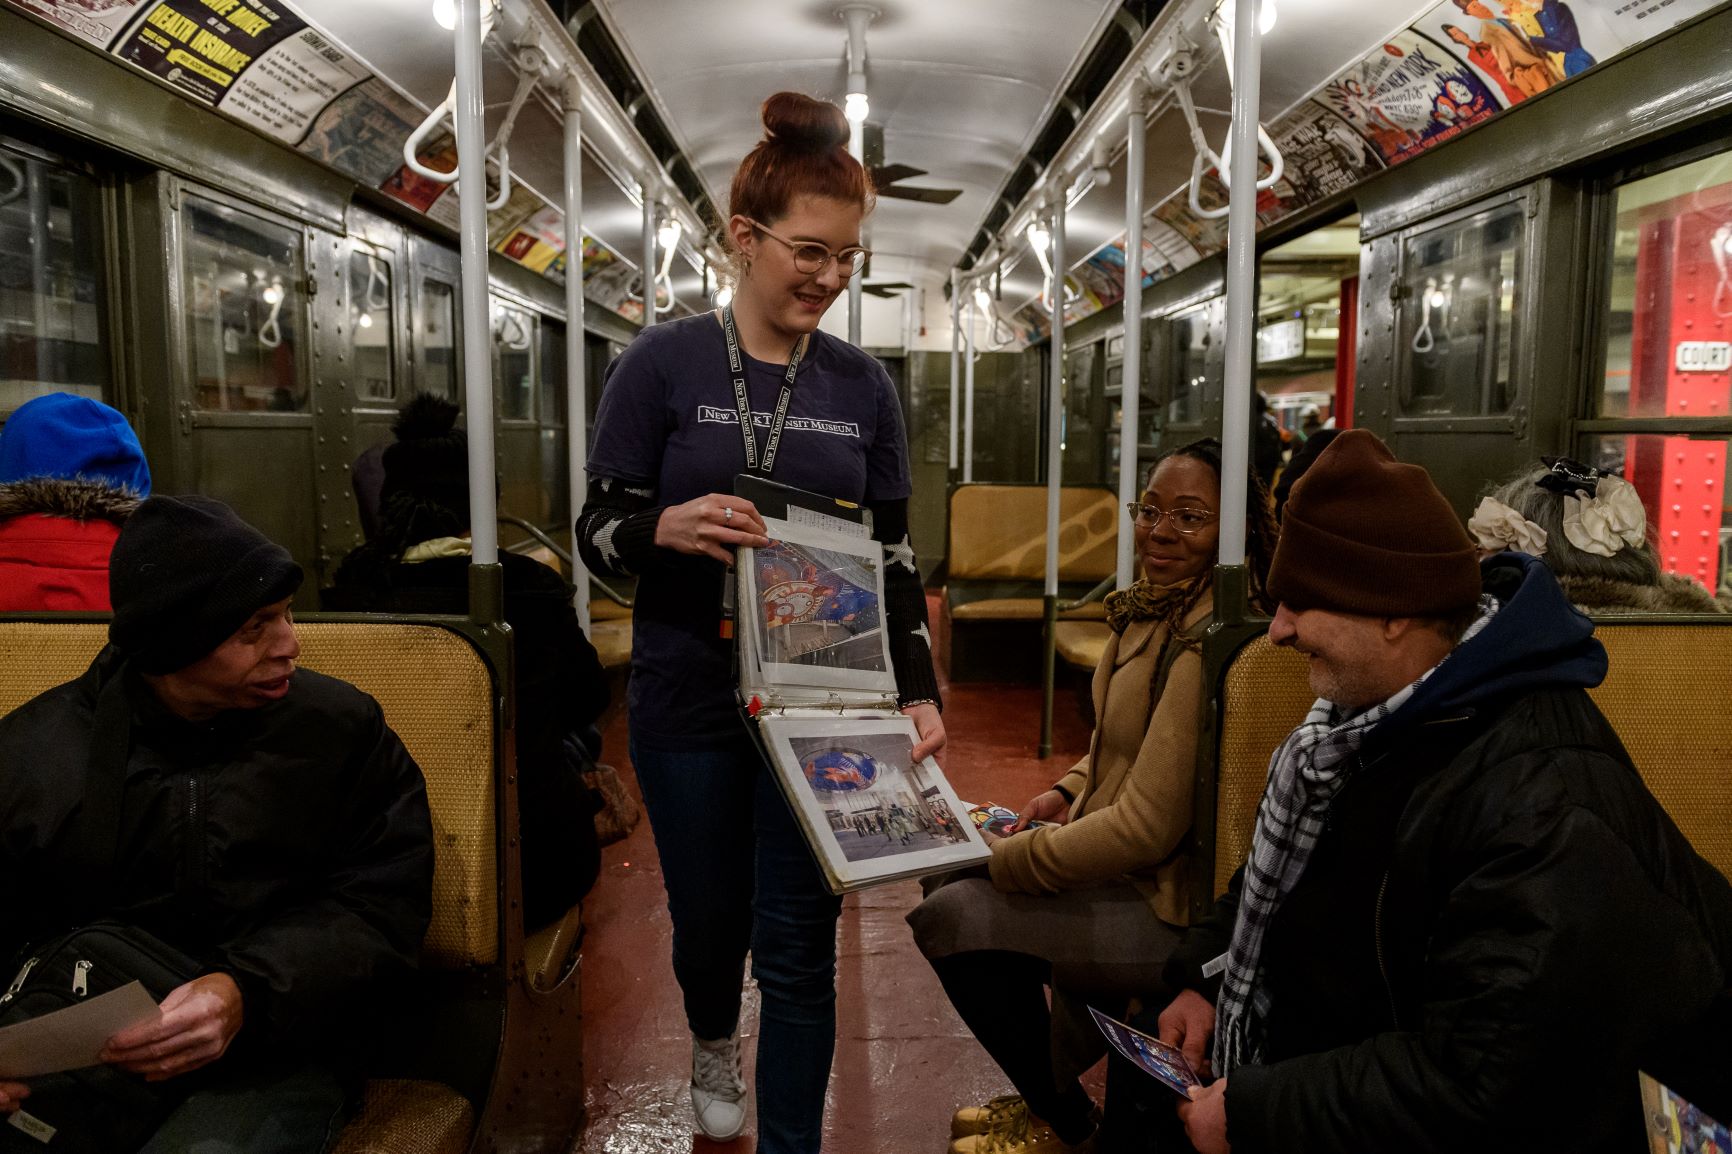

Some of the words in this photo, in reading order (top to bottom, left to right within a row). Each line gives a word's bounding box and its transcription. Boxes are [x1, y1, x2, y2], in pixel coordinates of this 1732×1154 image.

[147, 3, 199, 44] HEALTH
[189, 28, 251, 74] INSURANCE
[1386, 67, 1411, 89] NEW
[1682, 346, 1727, 366] COURT
[704, 408, 730, 421] NEW
[731, 411, 762, 424] YK
[763, 415, 809, 429] TNSIT
[811, 420, 854, 434] MUSEUM
